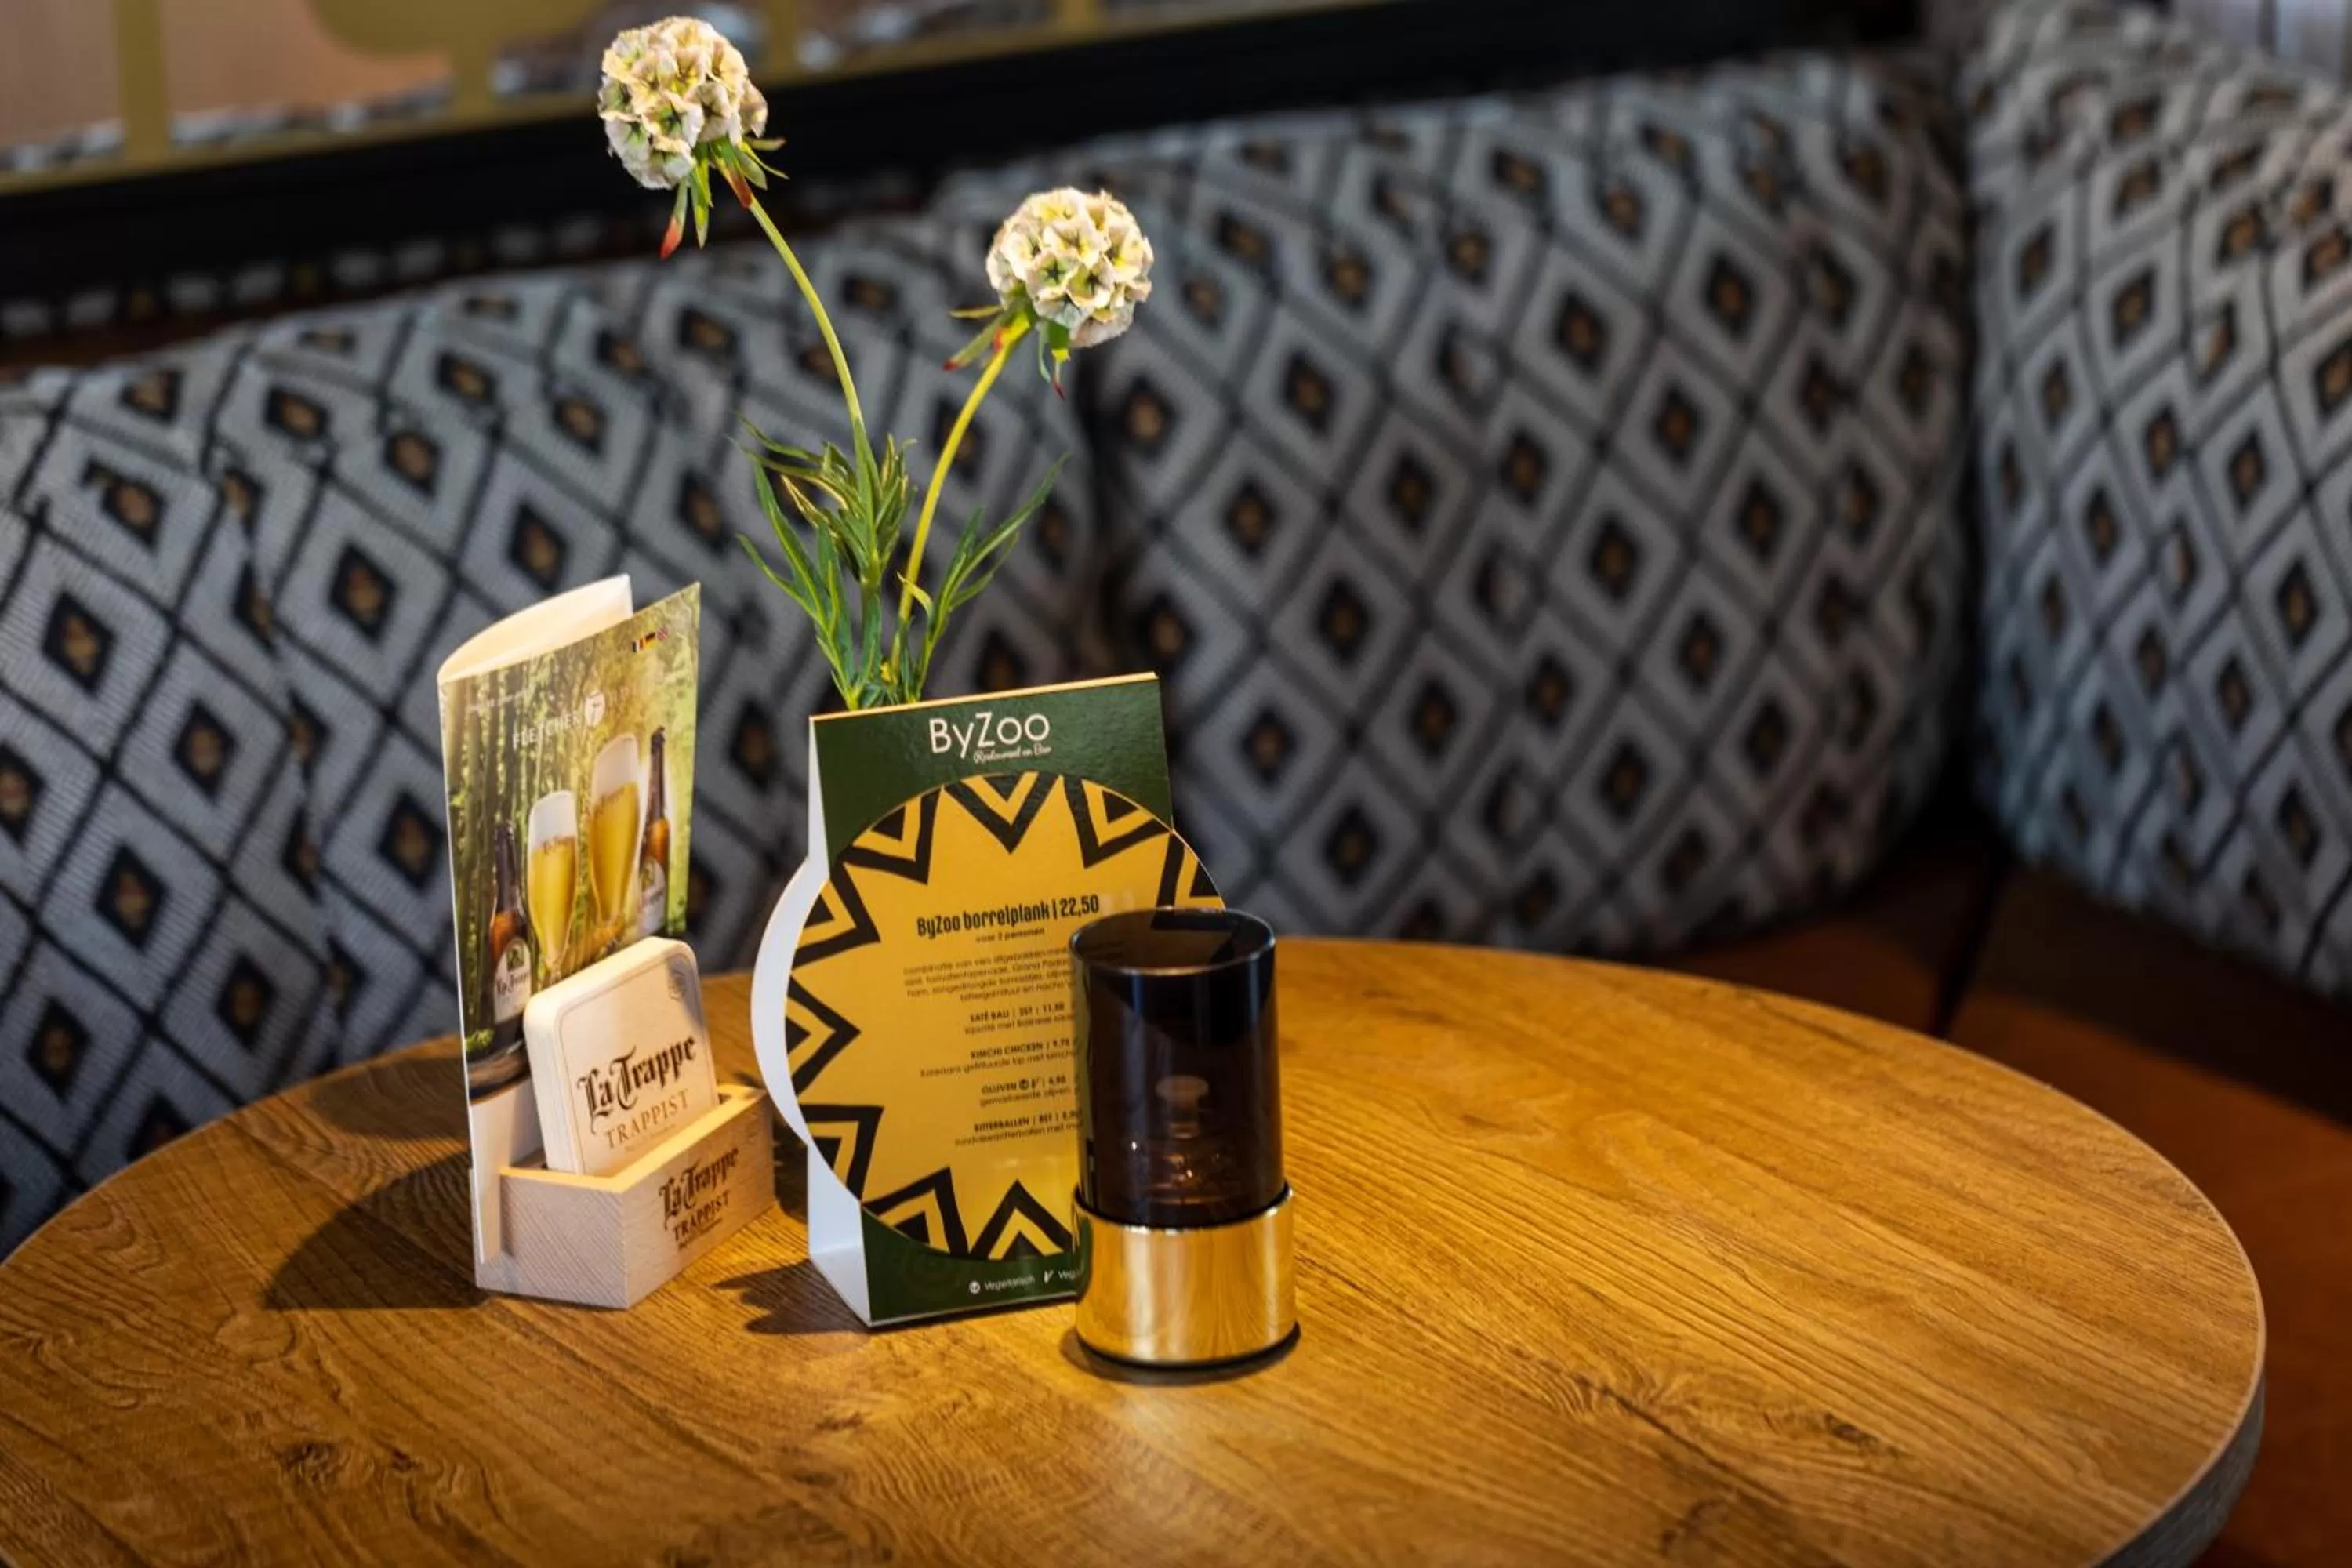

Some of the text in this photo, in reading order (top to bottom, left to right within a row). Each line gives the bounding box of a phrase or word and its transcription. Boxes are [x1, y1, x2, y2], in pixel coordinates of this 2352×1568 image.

[929, 711, 1050, 759] ByZoo
[916, 914, 960, 939] ByZoo
[963, 902, 1050, 930] borrelplank
[1059, 894, 1100, 917] 22,50
[577, 1035, 697, 1135] La Trappe
[605, 1087, 689, 1149] TRAPPIST
[659, 1148, 739, 1232] La Trappe
[674, 1189, 731, 1242] TRAPPIST
